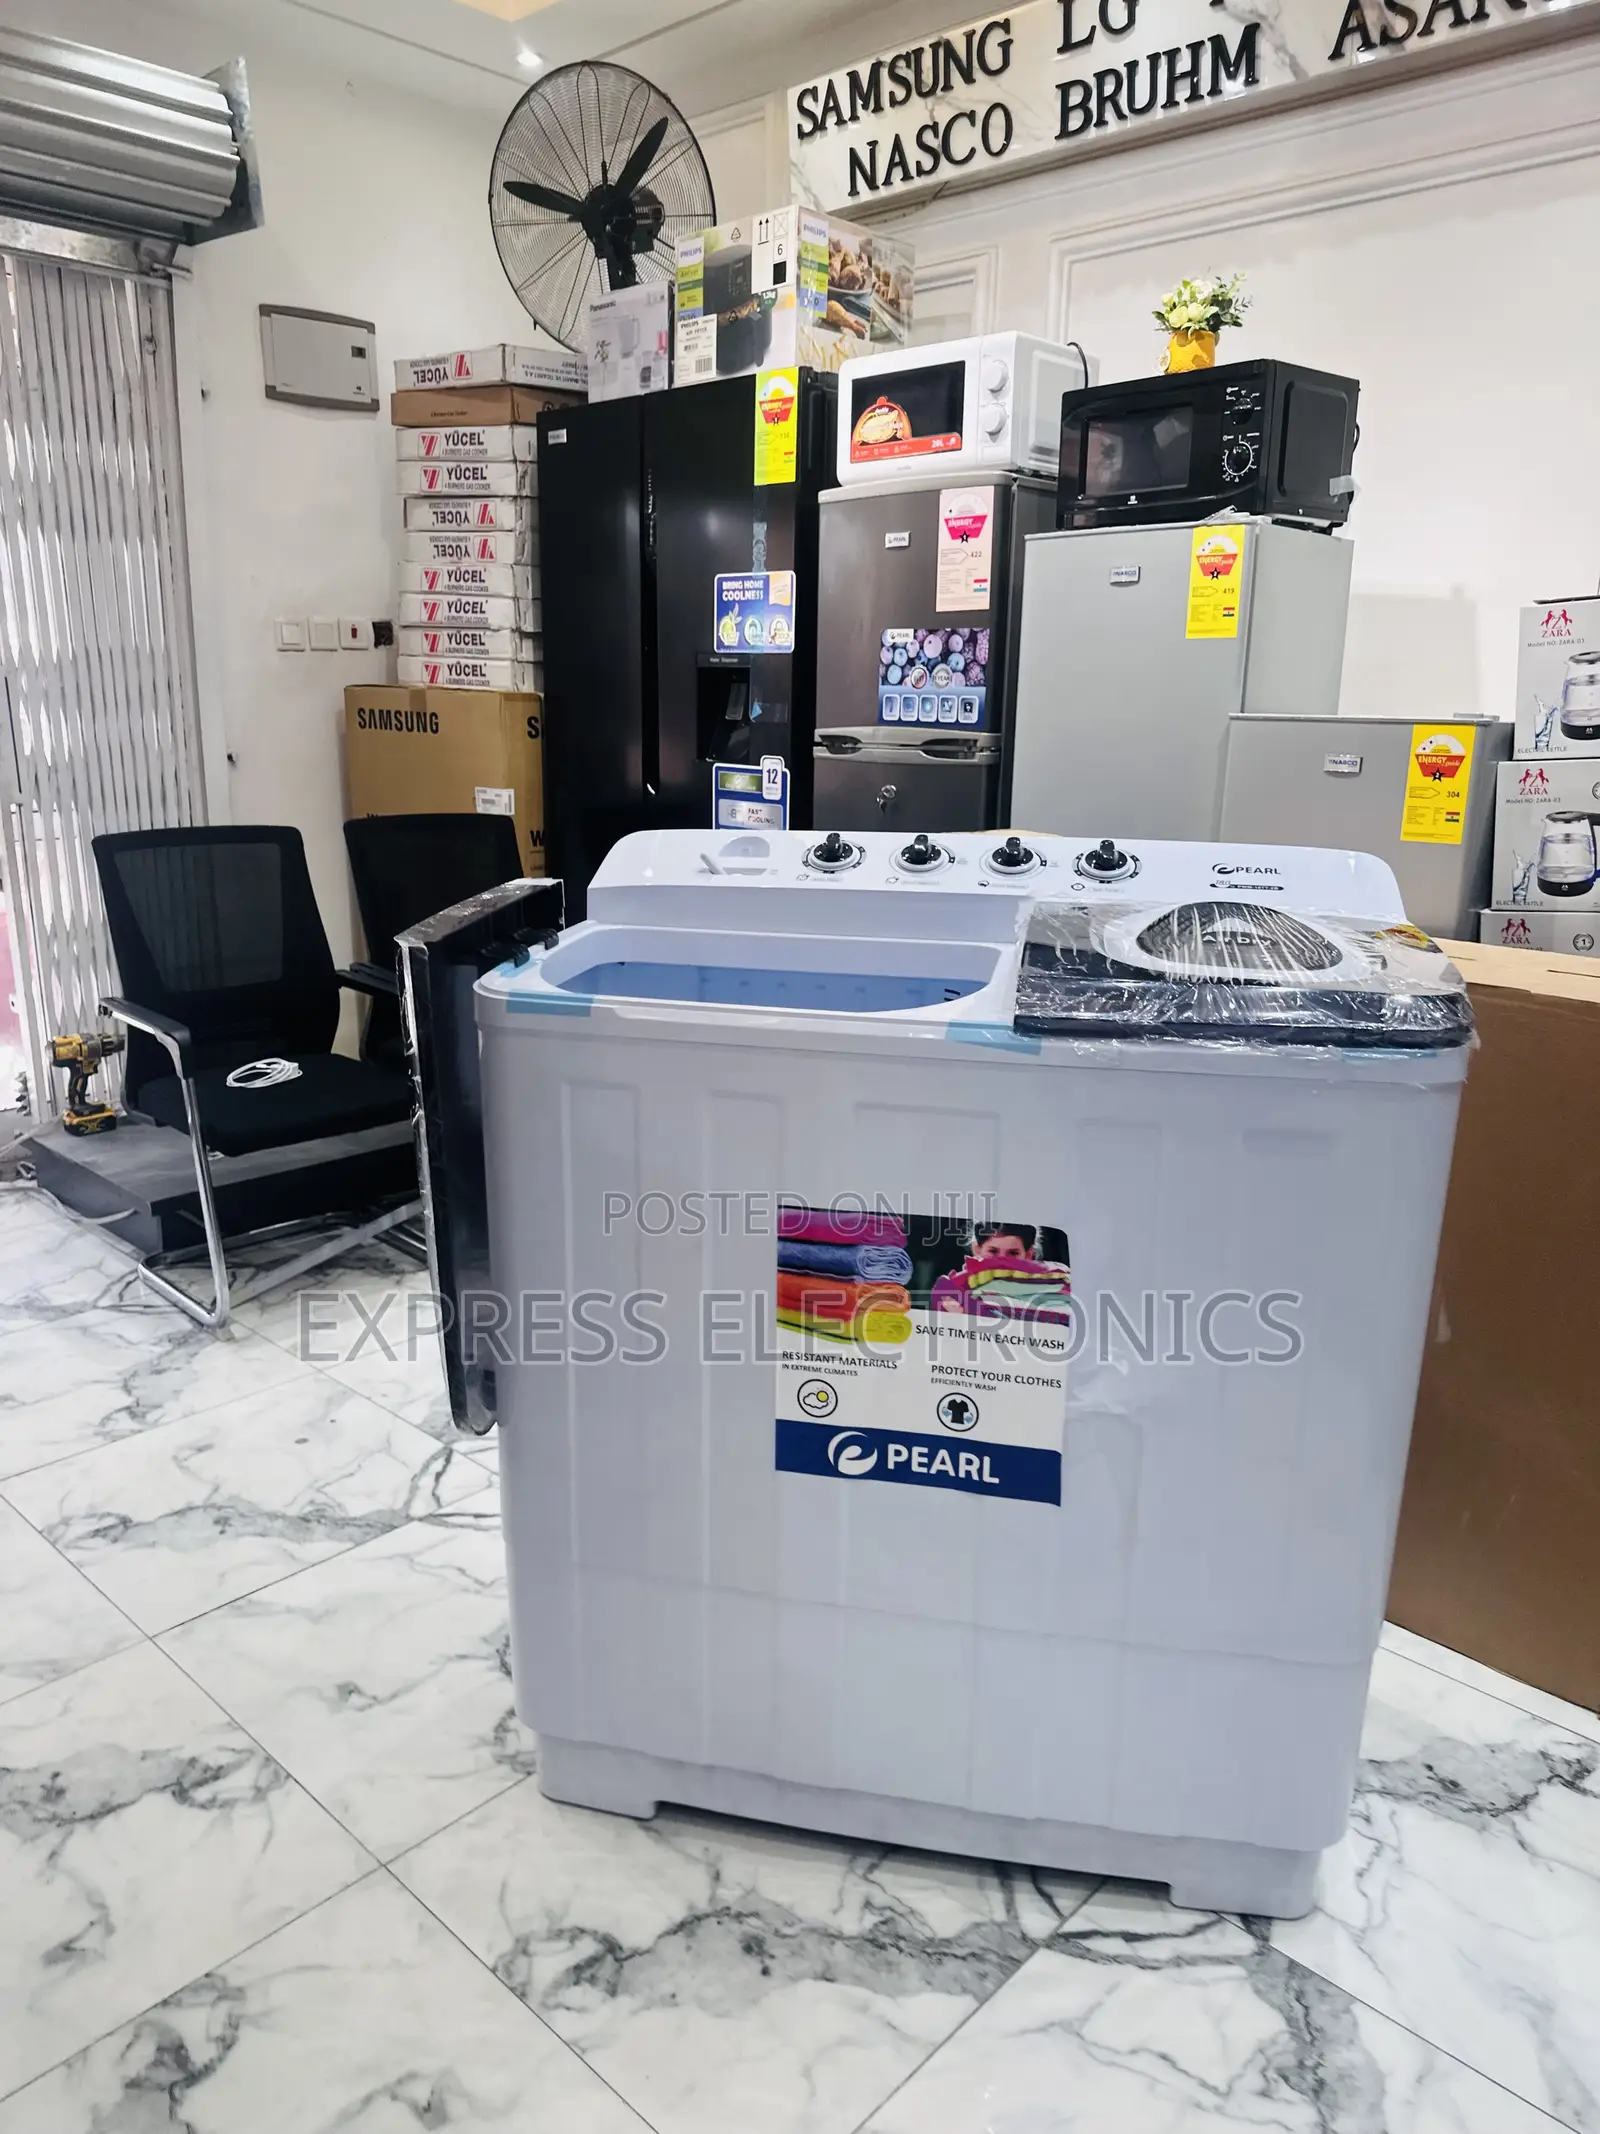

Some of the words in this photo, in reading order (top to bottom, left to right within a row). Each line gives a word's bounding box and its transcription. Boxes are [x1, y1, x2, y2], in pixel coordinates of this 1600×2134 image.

[797, 18, 1014, 140] SAMSUNG
[847, 102, 1013, 197] NASCO
[1054, 22, 1261, 140] BRUHM
[803, 223, 827, 238] PHILIPS
[680, 246, 703, 258] PHILIPS
[777, 243, 783, 256] 6
[413, 367, 449, 385] YÜCEL
[444, 430, 484, 446] YÜCEL
[446, 464, 487, 480] YÜCEL
[432, 511, 470, 526] YÜCEL
[433, 544, 470, 560] YÜCEL
[1198, 556, 1222, 564] ENERGY
[446, 566, 486, 583] YÜCEL
[744, 580, 764, 590] HOME
[722, 590, 764, 602] COOLNESS
[447, 598, 486, 614] YÜCEL
[446, 630, 486, 646] YÜCEL
[1540, 628, 1572, 638] ZARA
[446, 661, 486, 677] YÜCEL
[356, 707, 440, 735] SAMSUNG
[1418, 755, 1448, 765] ENERGY
[766, 768, 778, 785] 12
[1446, 790, 1460, 798] 304
[1520, 787, 1548, 796] ZARA
[1236, 866, 1282, 875] PEARL
[1502, 936, 1530, 944] ZARA
[916, 1324, 944, 1336] SAVE
[948, 1328, 976, 1340] TIME
[980, 1332, 991, 1342] IN
[995, 1334, 1025, 1346] EACH
[1028, 1338, 1065, 1350] WASH
[782, 1350, 836, 1364] RESISTANT
[839, 1356, 898, 1370] MATERIALS
[790, 1364, 822, 1374] EXTREME
[824, 1368, 858, 1376] CLIMATES
[931, 1364, 978, 1378] PROTECT
[980, 1370, 1012, 1382] YOUR
[1014, 1375, 1062, 1388] CLOTHES
[930, 1377, 972, 1388] EFFICIENTLY
[974, 1383, 997, 1392] WASH
[887, 1442, 1000, 1484] PEARL
